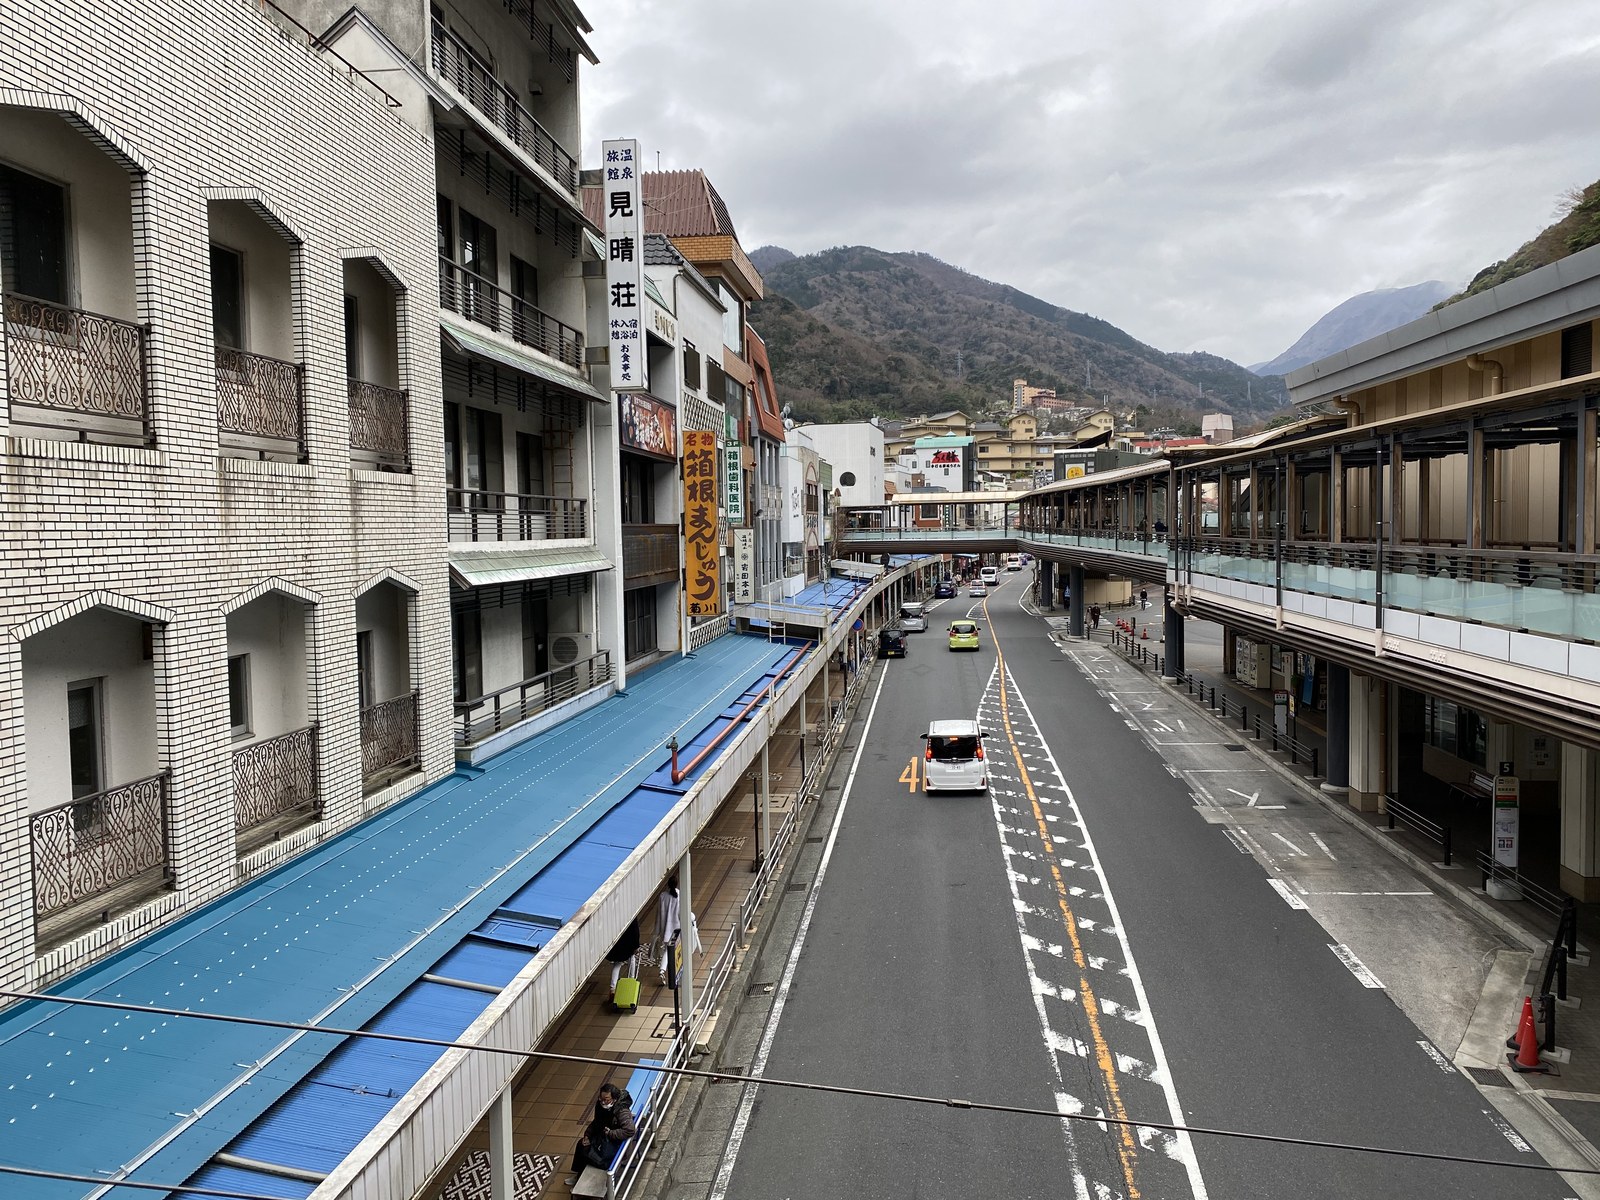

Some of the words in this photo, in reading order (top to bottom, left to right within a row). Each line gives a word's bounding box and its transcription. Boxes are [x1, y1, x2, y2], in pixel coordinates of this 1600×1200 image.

[608, 191, 637, 308] 見晴荘
[620, 343, 632, 381] お食事処
[685, 432, 714, 447] 名物
[727, 450, 740, 514] 箱根歯科医院
[686, 448, 719, 601] 箱根まんじゅう
[690, 602, 717, 614] 菊川
[1503, 763, 1511, 773] 5
